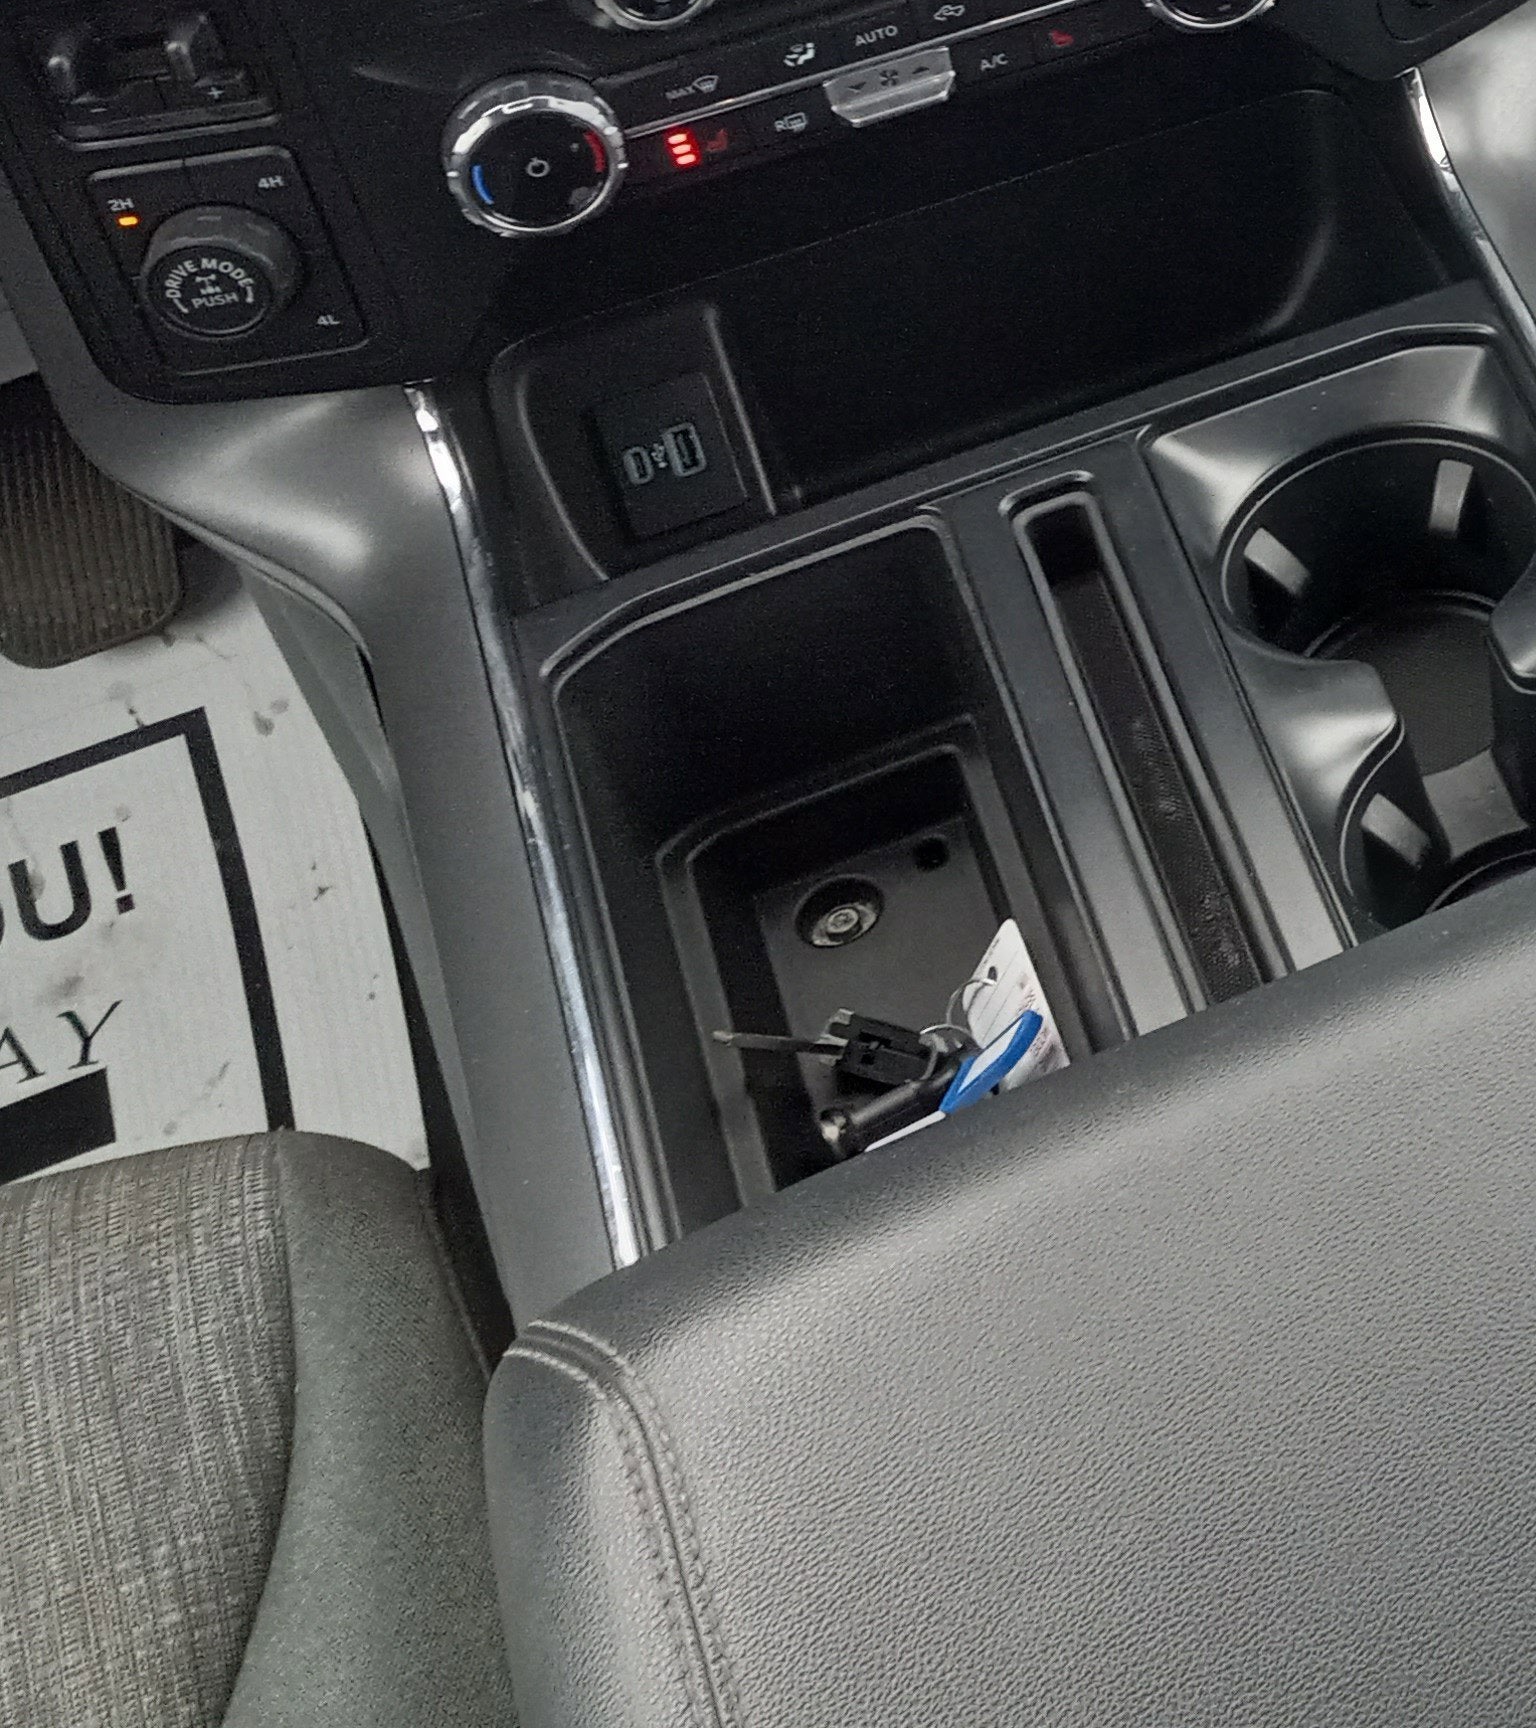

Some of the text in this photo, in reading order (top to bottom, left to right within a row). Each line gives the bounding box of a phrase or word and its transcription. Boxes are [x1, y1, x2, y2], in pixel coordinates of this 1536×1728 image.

[854, 25, 899, 47] AUTO
[979, 52, 1010, 72] A/C
[257, 174, 284, 190] 4H
[107, 196, 135, 212] 2H
[164, 257, 255, 299] DRIVE MODE
[190, 292, 240, 309] PUSH
[316, 314, 341, 327] 4L
[0, 826, 136, 941] U!
